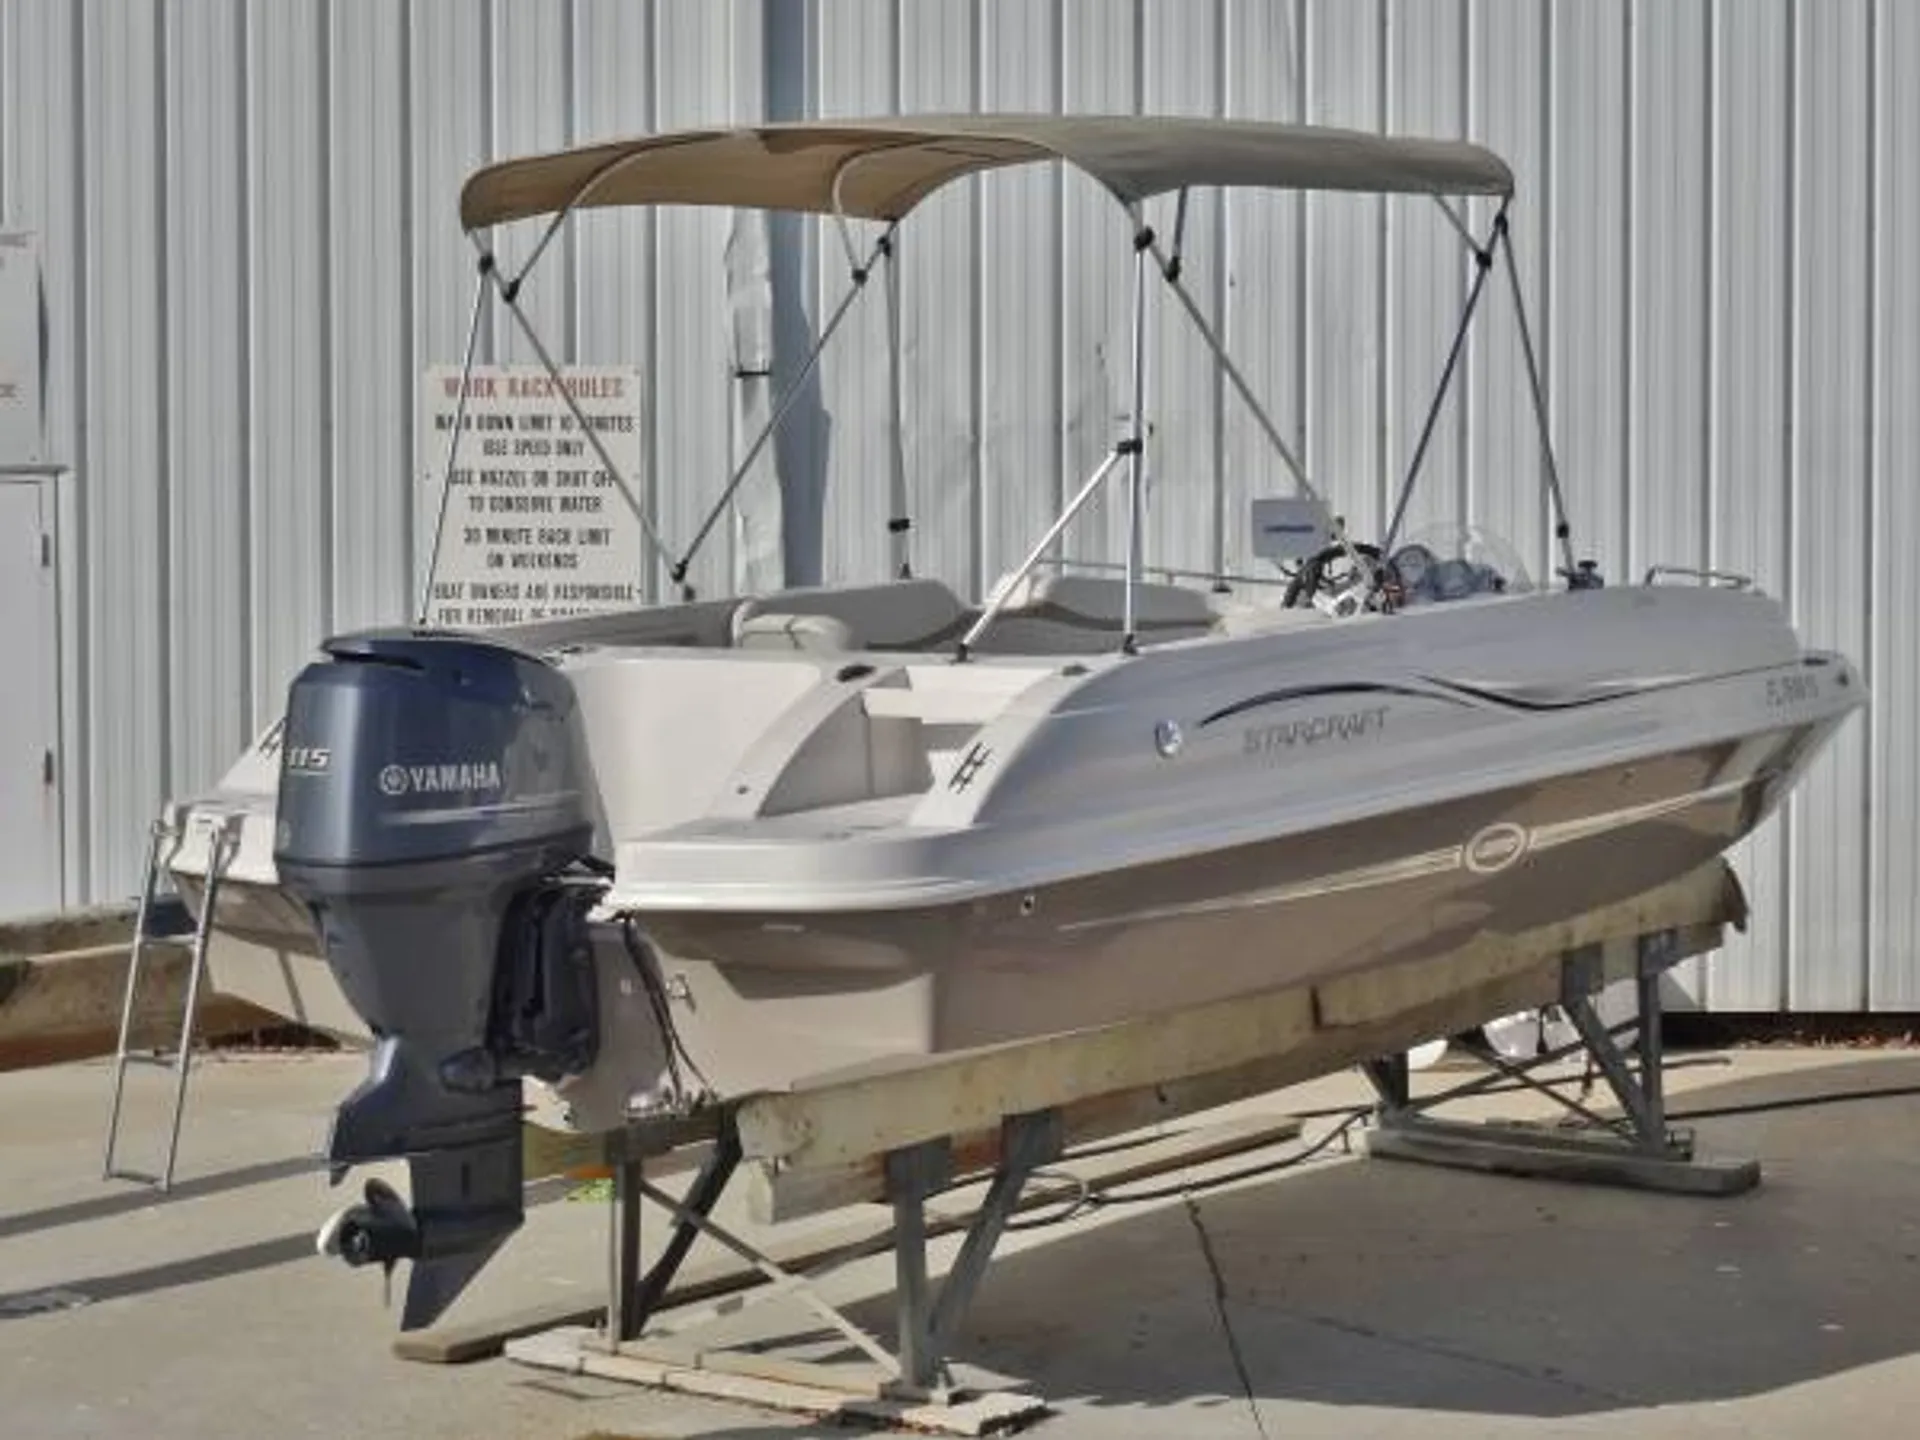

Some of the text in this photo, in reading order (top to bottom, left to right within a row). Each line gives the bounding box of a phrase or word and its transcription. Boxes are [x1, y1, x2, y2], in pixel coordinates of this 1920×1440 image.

[477, 415, 513, 430] DOWN
[469, 496, 601, 512] TO CONSERVE WATER
[486, 528, 532, 545] MINUTE
[578, 528, 610, 545] LIMIT
[487, 554, 577, 568] ON WEEKENDS
[1243, 706, 1391, 754] STARCRAFT
[287, 748, 332, 768] 115
[410, 762, 500, 792] YAMAHA
